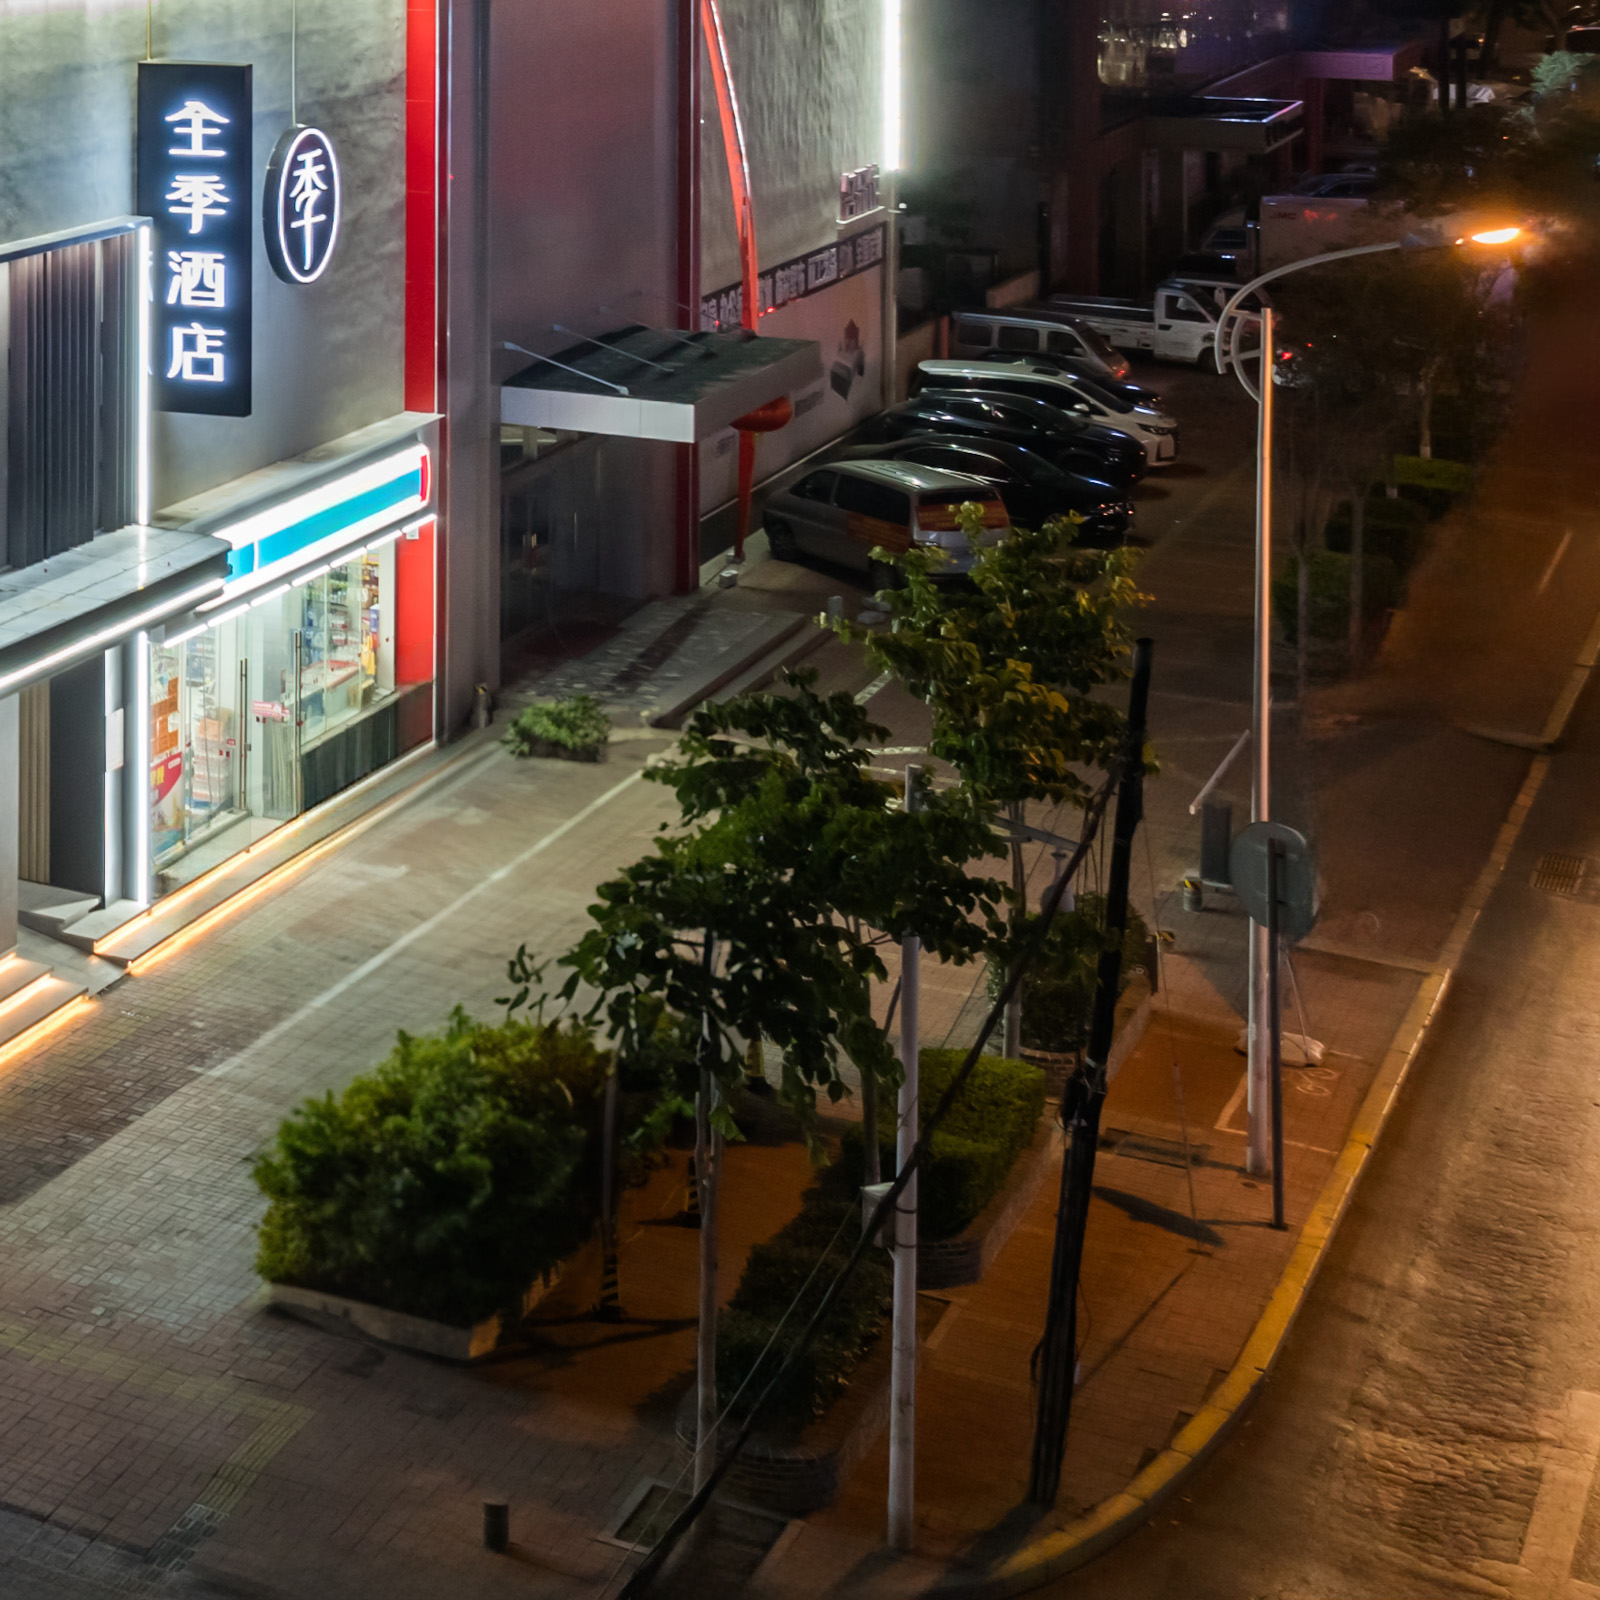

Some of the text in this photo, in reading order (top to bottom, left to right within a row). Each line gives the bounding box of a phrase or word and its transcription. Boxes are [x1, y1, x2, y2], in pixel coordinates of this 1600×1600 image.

[165, 100, 230, 382] 全季酒店
[289, 148, 328, 271] 季
